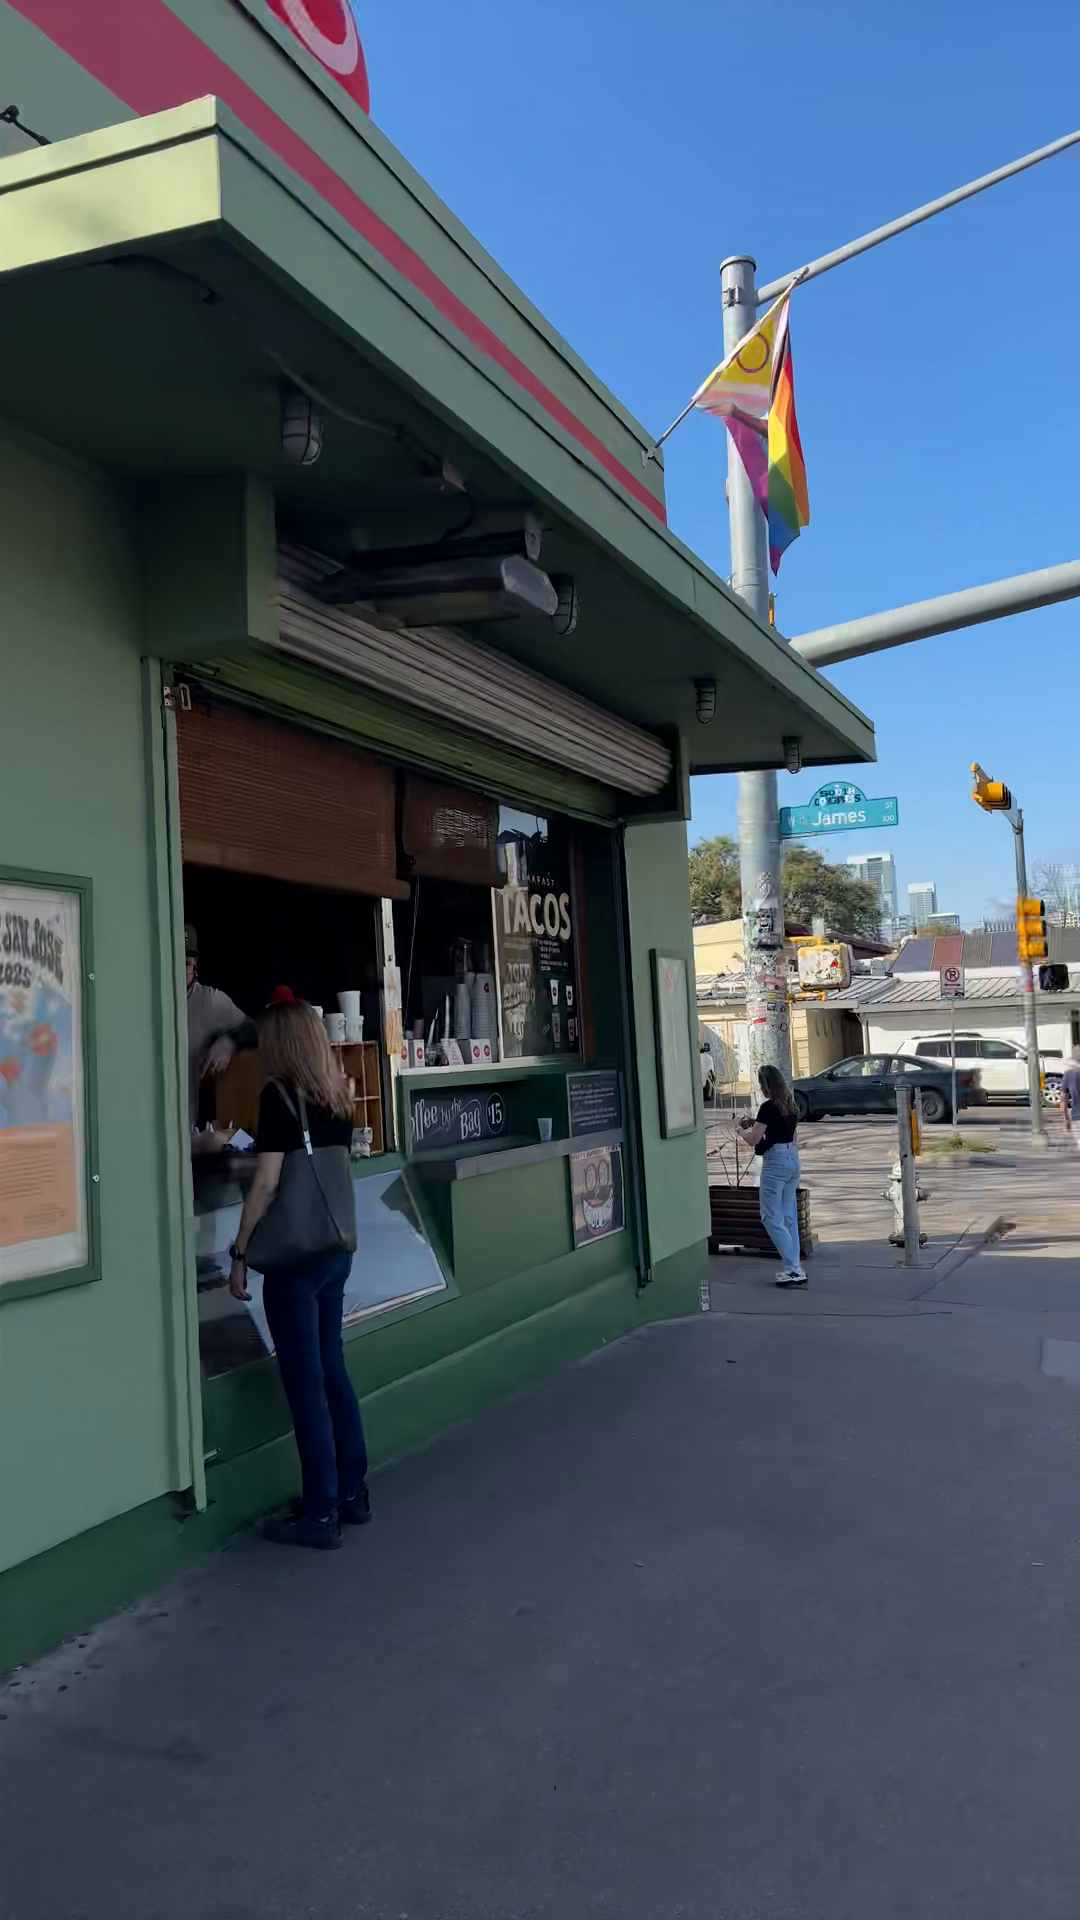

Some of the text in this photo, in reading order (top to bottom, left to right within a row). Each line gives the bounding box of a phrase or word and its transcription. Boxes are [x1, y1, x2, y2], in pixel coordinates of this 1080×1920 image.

[812, 809, 866, 826] James
[885, 801, 893, 809] ST
[502, 892, 572, 940] TACOS
[2, 912, 31, 959] SAN
[460, 1107, 482, 1139] Bag
